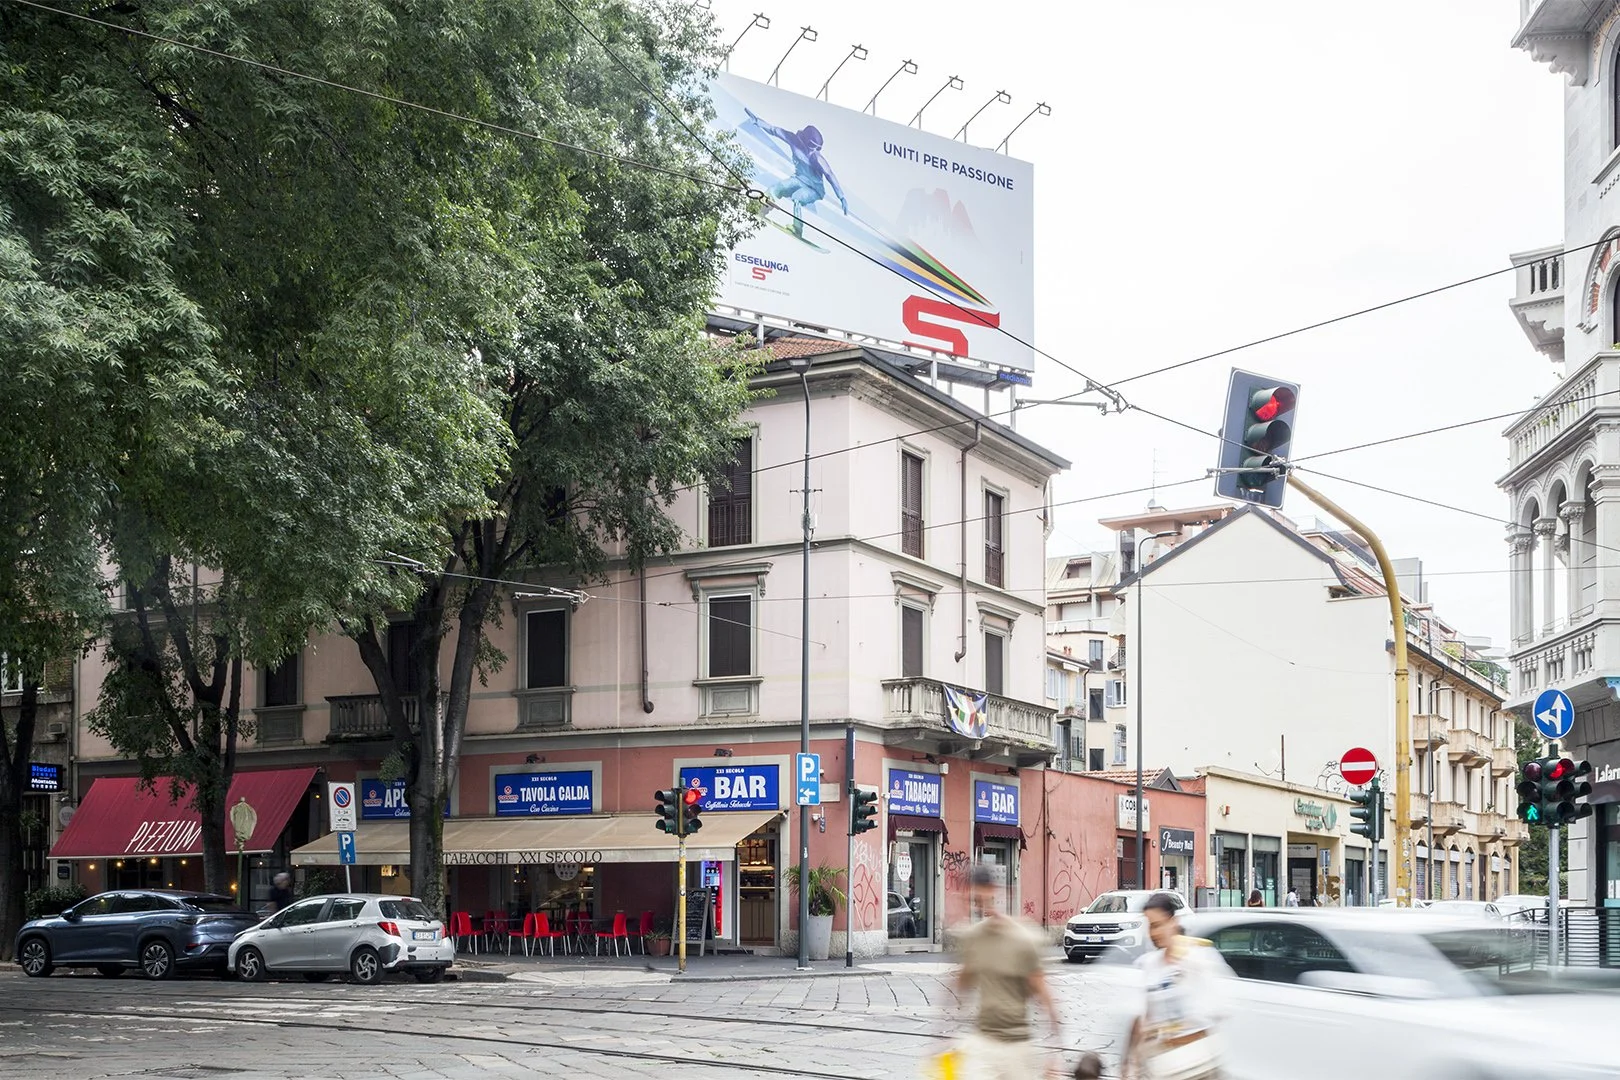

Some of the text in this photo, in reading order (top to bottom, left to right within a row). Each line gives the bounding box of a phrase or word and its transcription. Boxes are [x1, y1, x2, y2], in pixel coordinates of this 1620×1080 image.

[884, 142, 1014, 190] UNITI PER PASSIONE
[735, 253, 789, 272] ESSELUNGA
[802, 757, 815, 782] P
[520, 787, 556, 802] TAVOLA
[558, 785, 589, 801] CALDA
[714, 775, 766, 799] BAR
[905, 781, 939, 804] TABACCHI
[992, 792, 1015, 814] BAR
[124, 820, 202, 853] PIZZIUM
[342, 834, 351, 850] P
[442, 850, 602, 864] TABACCHI XXI SECOLO
